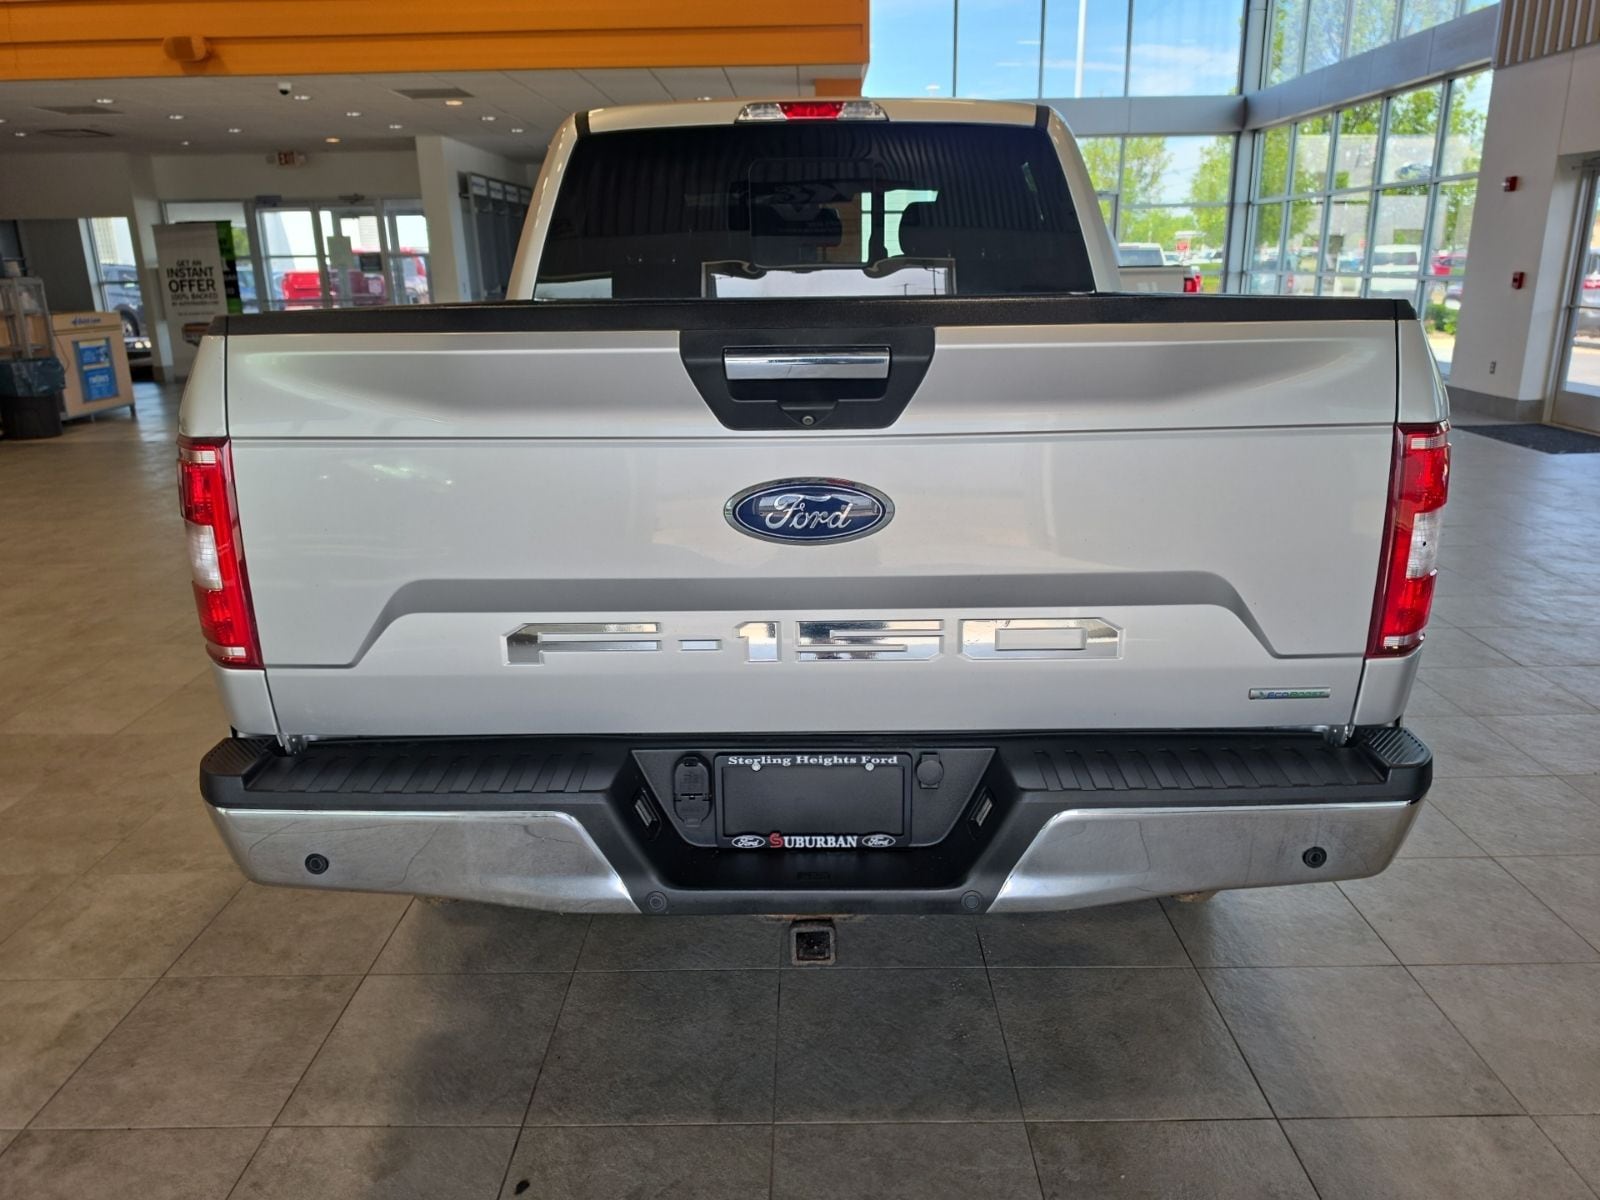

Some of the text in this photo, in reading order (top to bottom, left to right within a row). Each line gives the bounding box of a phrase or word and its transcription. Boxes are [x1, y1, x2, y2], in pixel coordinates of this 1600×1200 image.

[176, 259, 190, 267] GET
[166, 266, 214, 278] INSTANT
[168, 278, 216, 293] OFFER
[765, 493, 853, 529] Ford
[504, 616, 1123, 666] F-150
[728, 755, 898, 767] Sterling Heights Ford
[769, 832, 858, 848] SUBURBAN
